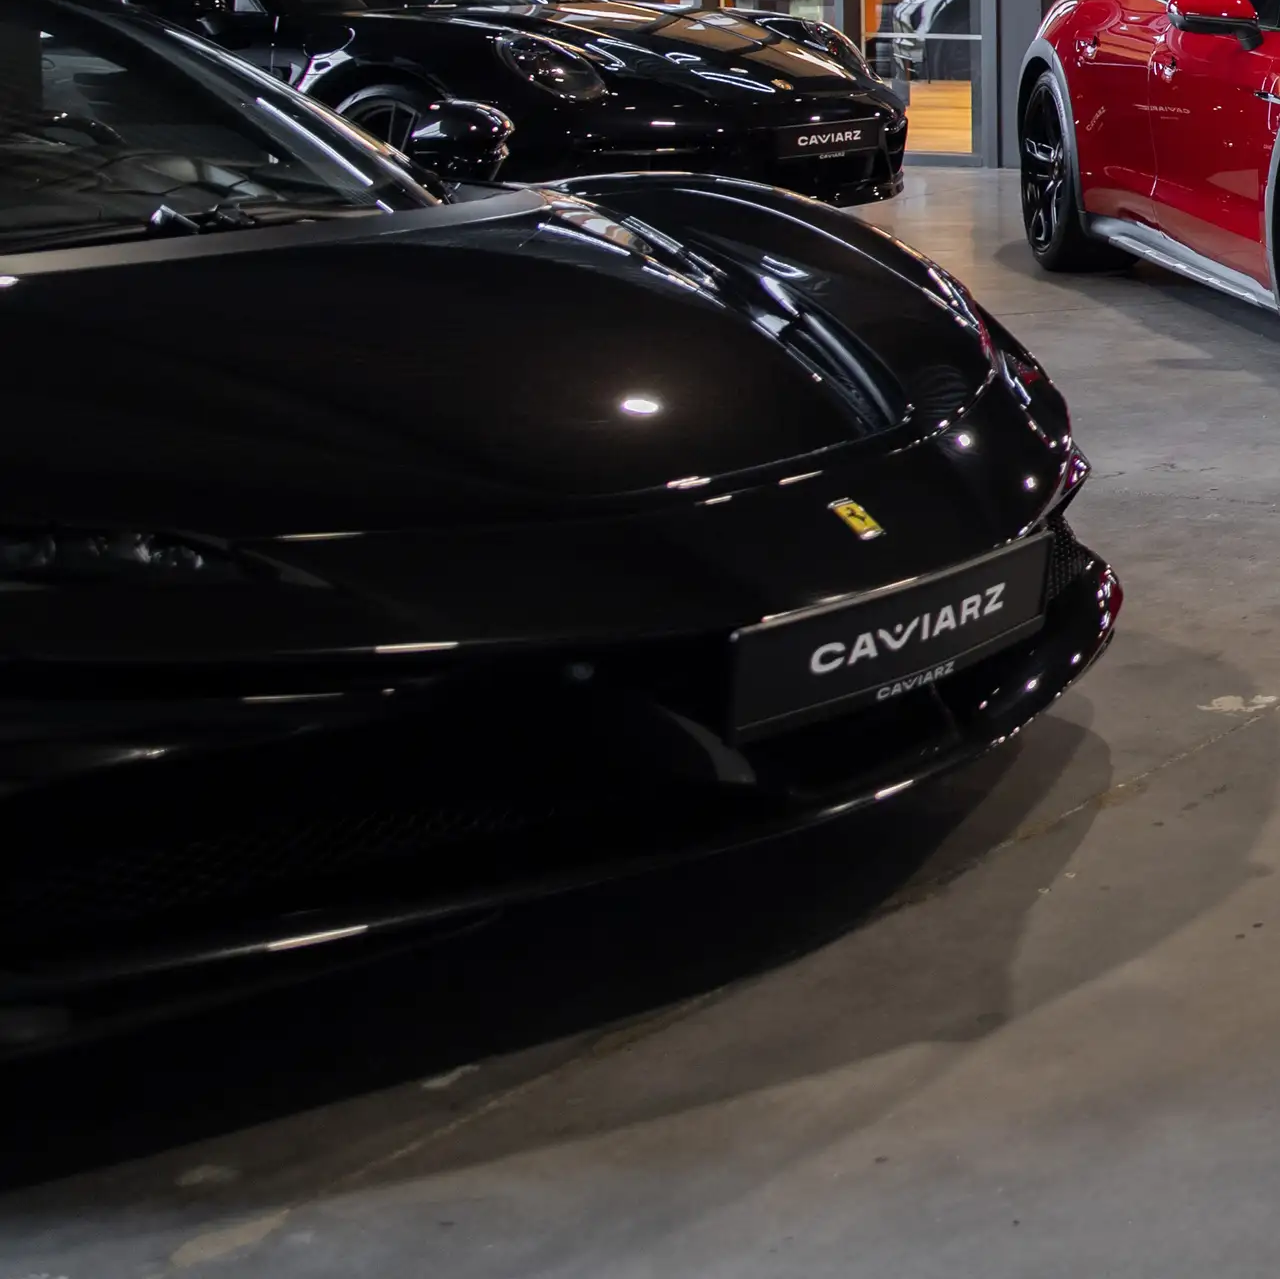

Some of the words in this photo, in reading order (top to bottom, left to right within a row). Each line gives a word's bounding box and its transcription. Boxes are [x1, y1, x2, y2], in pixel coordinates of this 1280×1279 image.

[797, 130, 862, 146] CAVIARZ
[819, 151, 846, 159] CAVIARZ
[809, 582, 1006, 674] CAVIARZ
[876, 661, 955, 701] CAVIARZ
